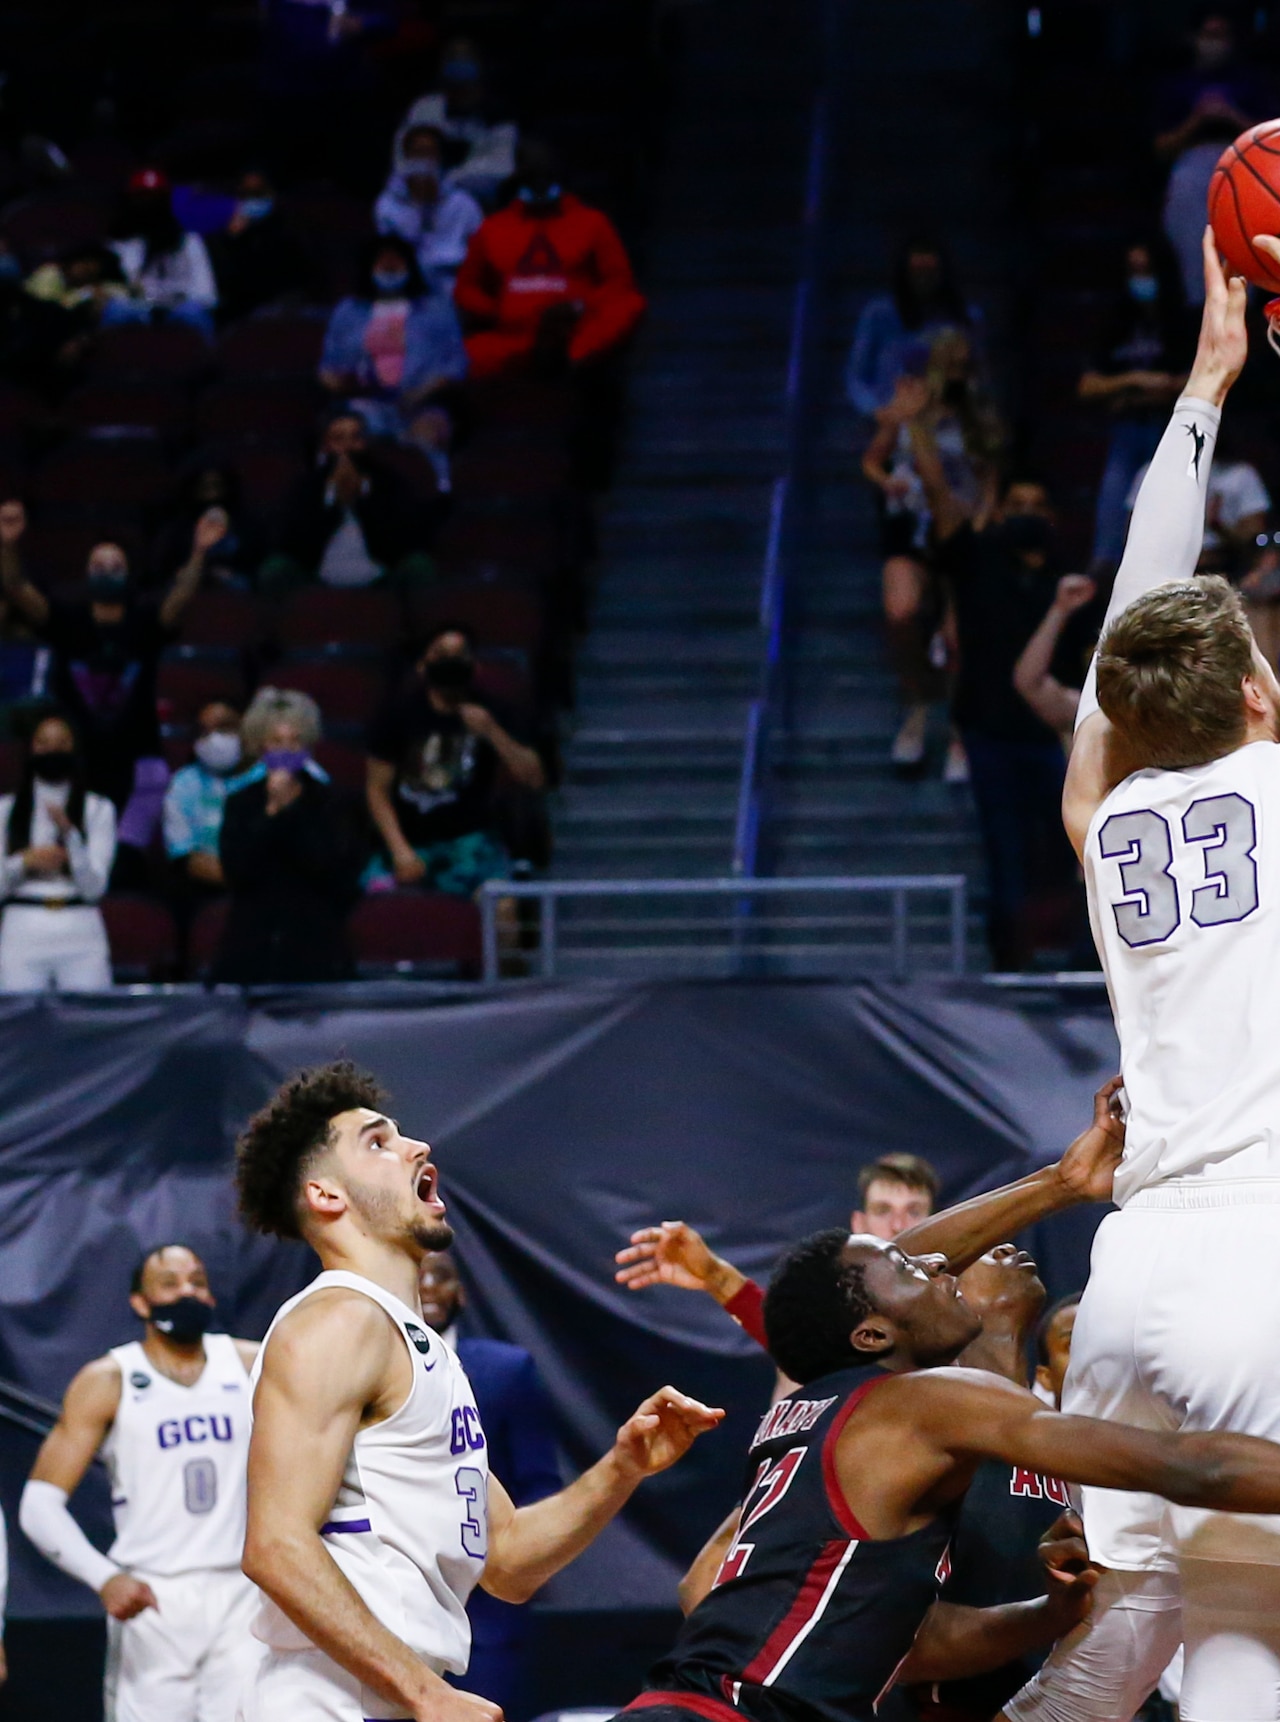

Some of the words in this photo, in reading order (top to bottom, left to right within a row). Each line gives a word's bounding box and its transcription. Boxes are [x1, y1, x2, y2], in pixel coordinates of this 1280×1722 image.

[1098, 792, 1260, 948] 33
[157, 1415, 233, 1449] GCU
[450, 1405, 486, 1456] GC
[184, 1457, 218, 1515] 0
[455, 1466, 489, 1560] 3
